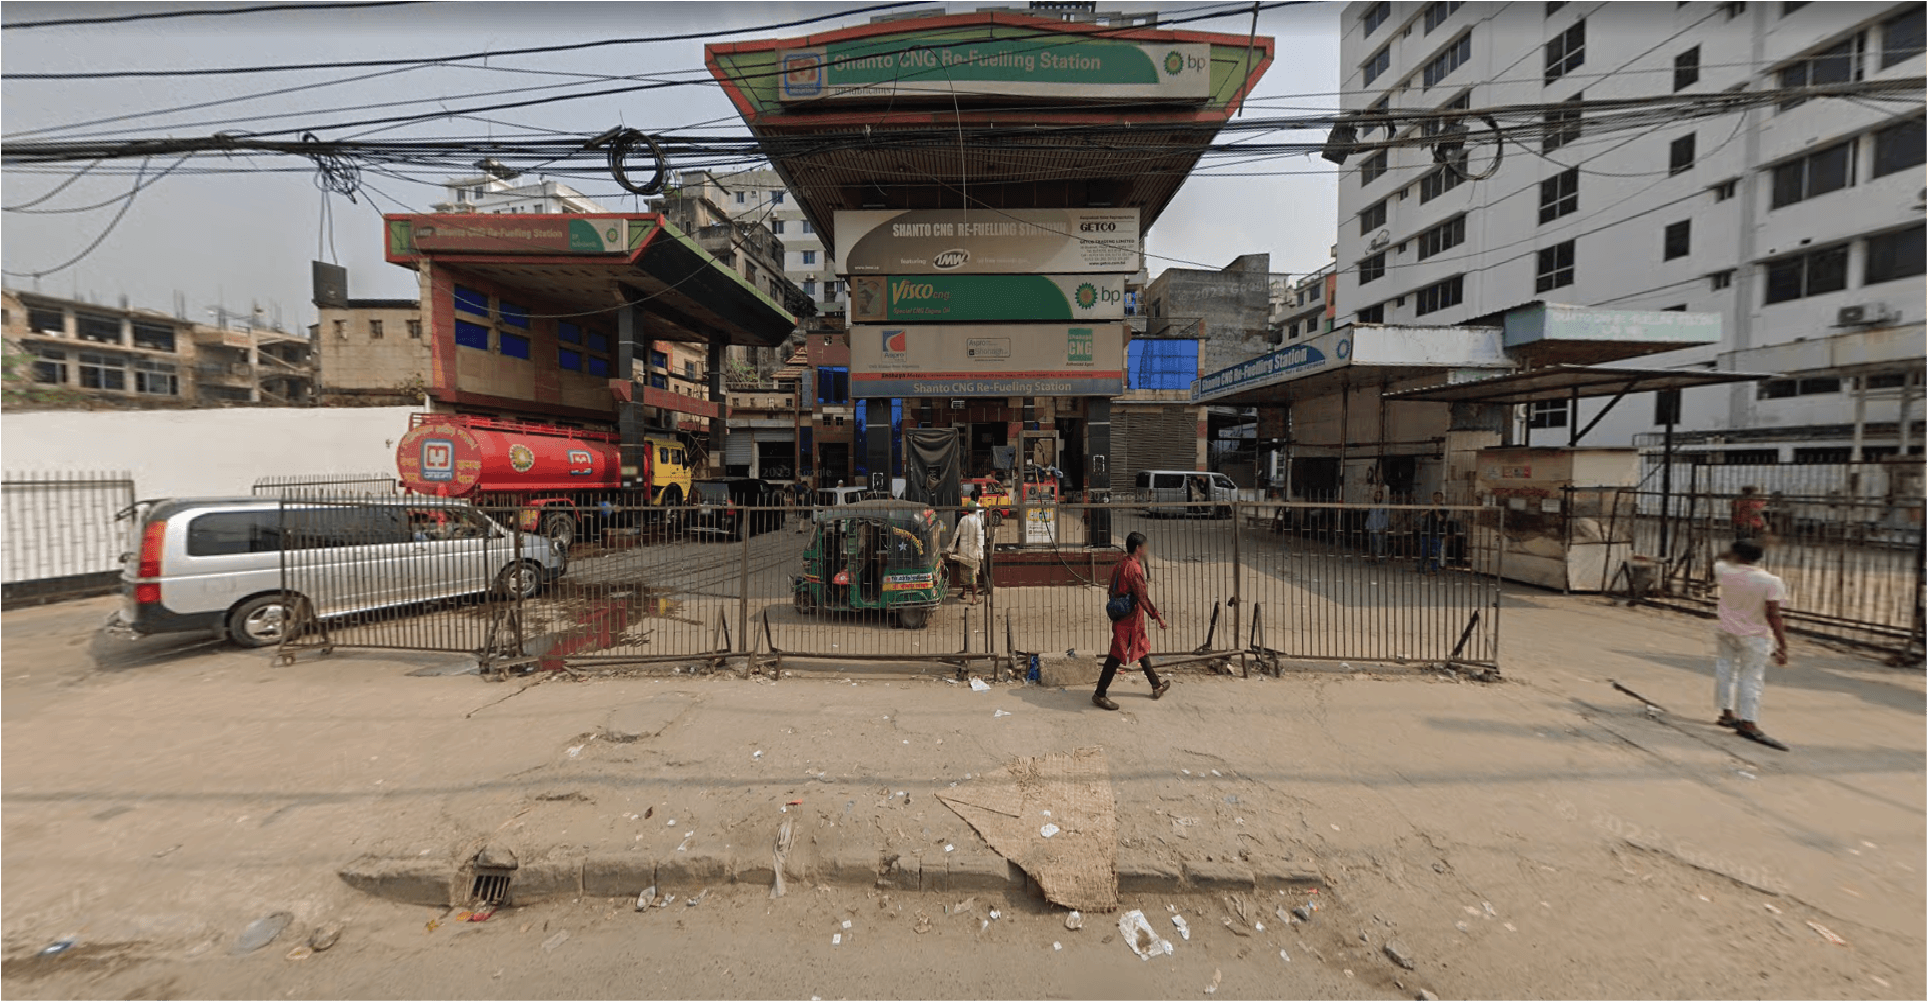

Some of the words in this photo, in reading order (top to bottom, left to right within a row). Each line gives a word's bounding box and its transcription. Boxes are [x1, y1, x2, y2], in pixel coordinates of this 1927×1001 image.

[834, 53, 893, 72] Shanto
[899, 49, 936, 68] CNG
[942, 48, 1035, 72] Re-Fuelling
[1040, 51, 1102, 70] Station
[1188, 54, 1206, 72] bp
[533, 227, 563, 239] Station
[892, 222, 932, 237] SHANTO
[933, 222, 954, 237] CNG
[957, 222, 1017, 236] RE-FUELLING
[1080, 221, 1116, 233] GETCO
[901, 257, 927, 265] featuring
[1101, 286, 1121, 306] bp
[893, 306, 913, 315] Special
[975, 347, 1003, 356] Shohagh
[1068, 341, 1092, 355] CNG
[1274, 347, 1308, 370] Station
[913, 382, 950, 394] Shanto
[951, 382, 974, 393] CNG
[976, 381, 1032, 395] Re-Fuelling
[1035, 381, 1072, 392] Station
